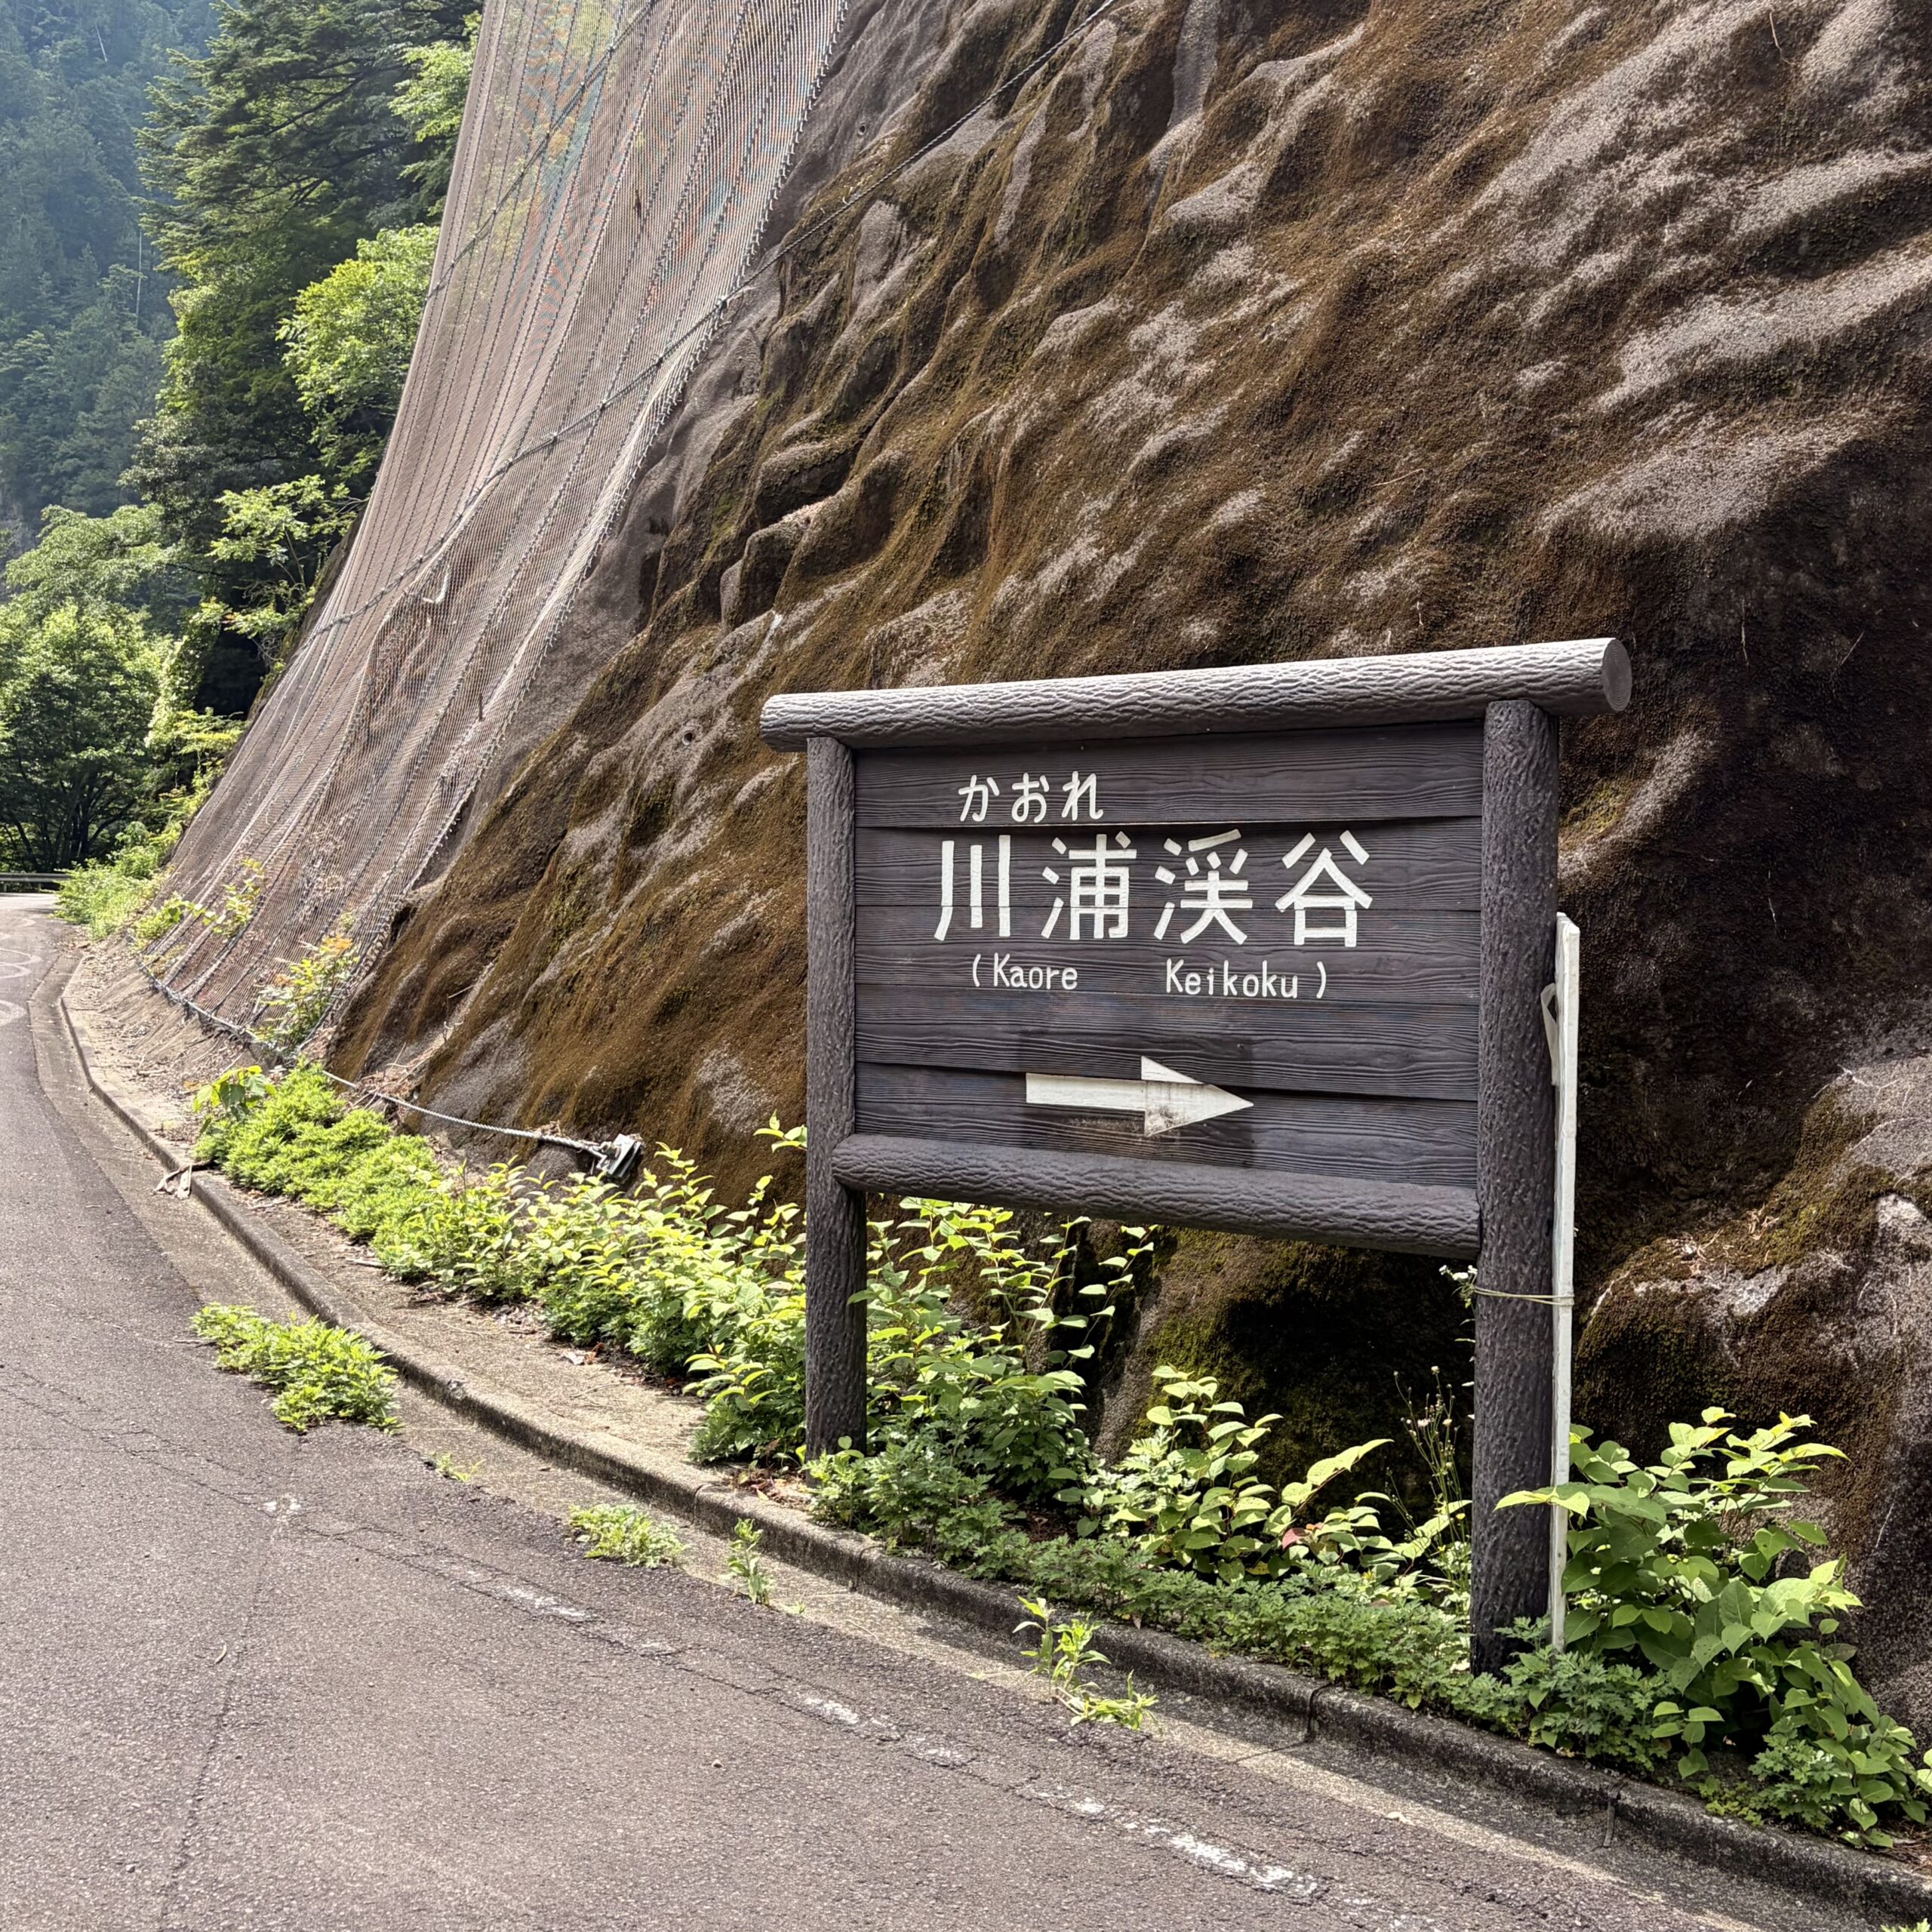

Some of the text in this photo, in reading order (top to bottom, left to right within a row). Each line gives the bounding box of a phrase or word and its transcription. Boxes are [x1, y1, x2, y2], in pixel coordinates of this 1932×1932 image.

[958, 771, 1104, 823] かおれ
[934, 829, 1374, 948] 川浦渓谷
